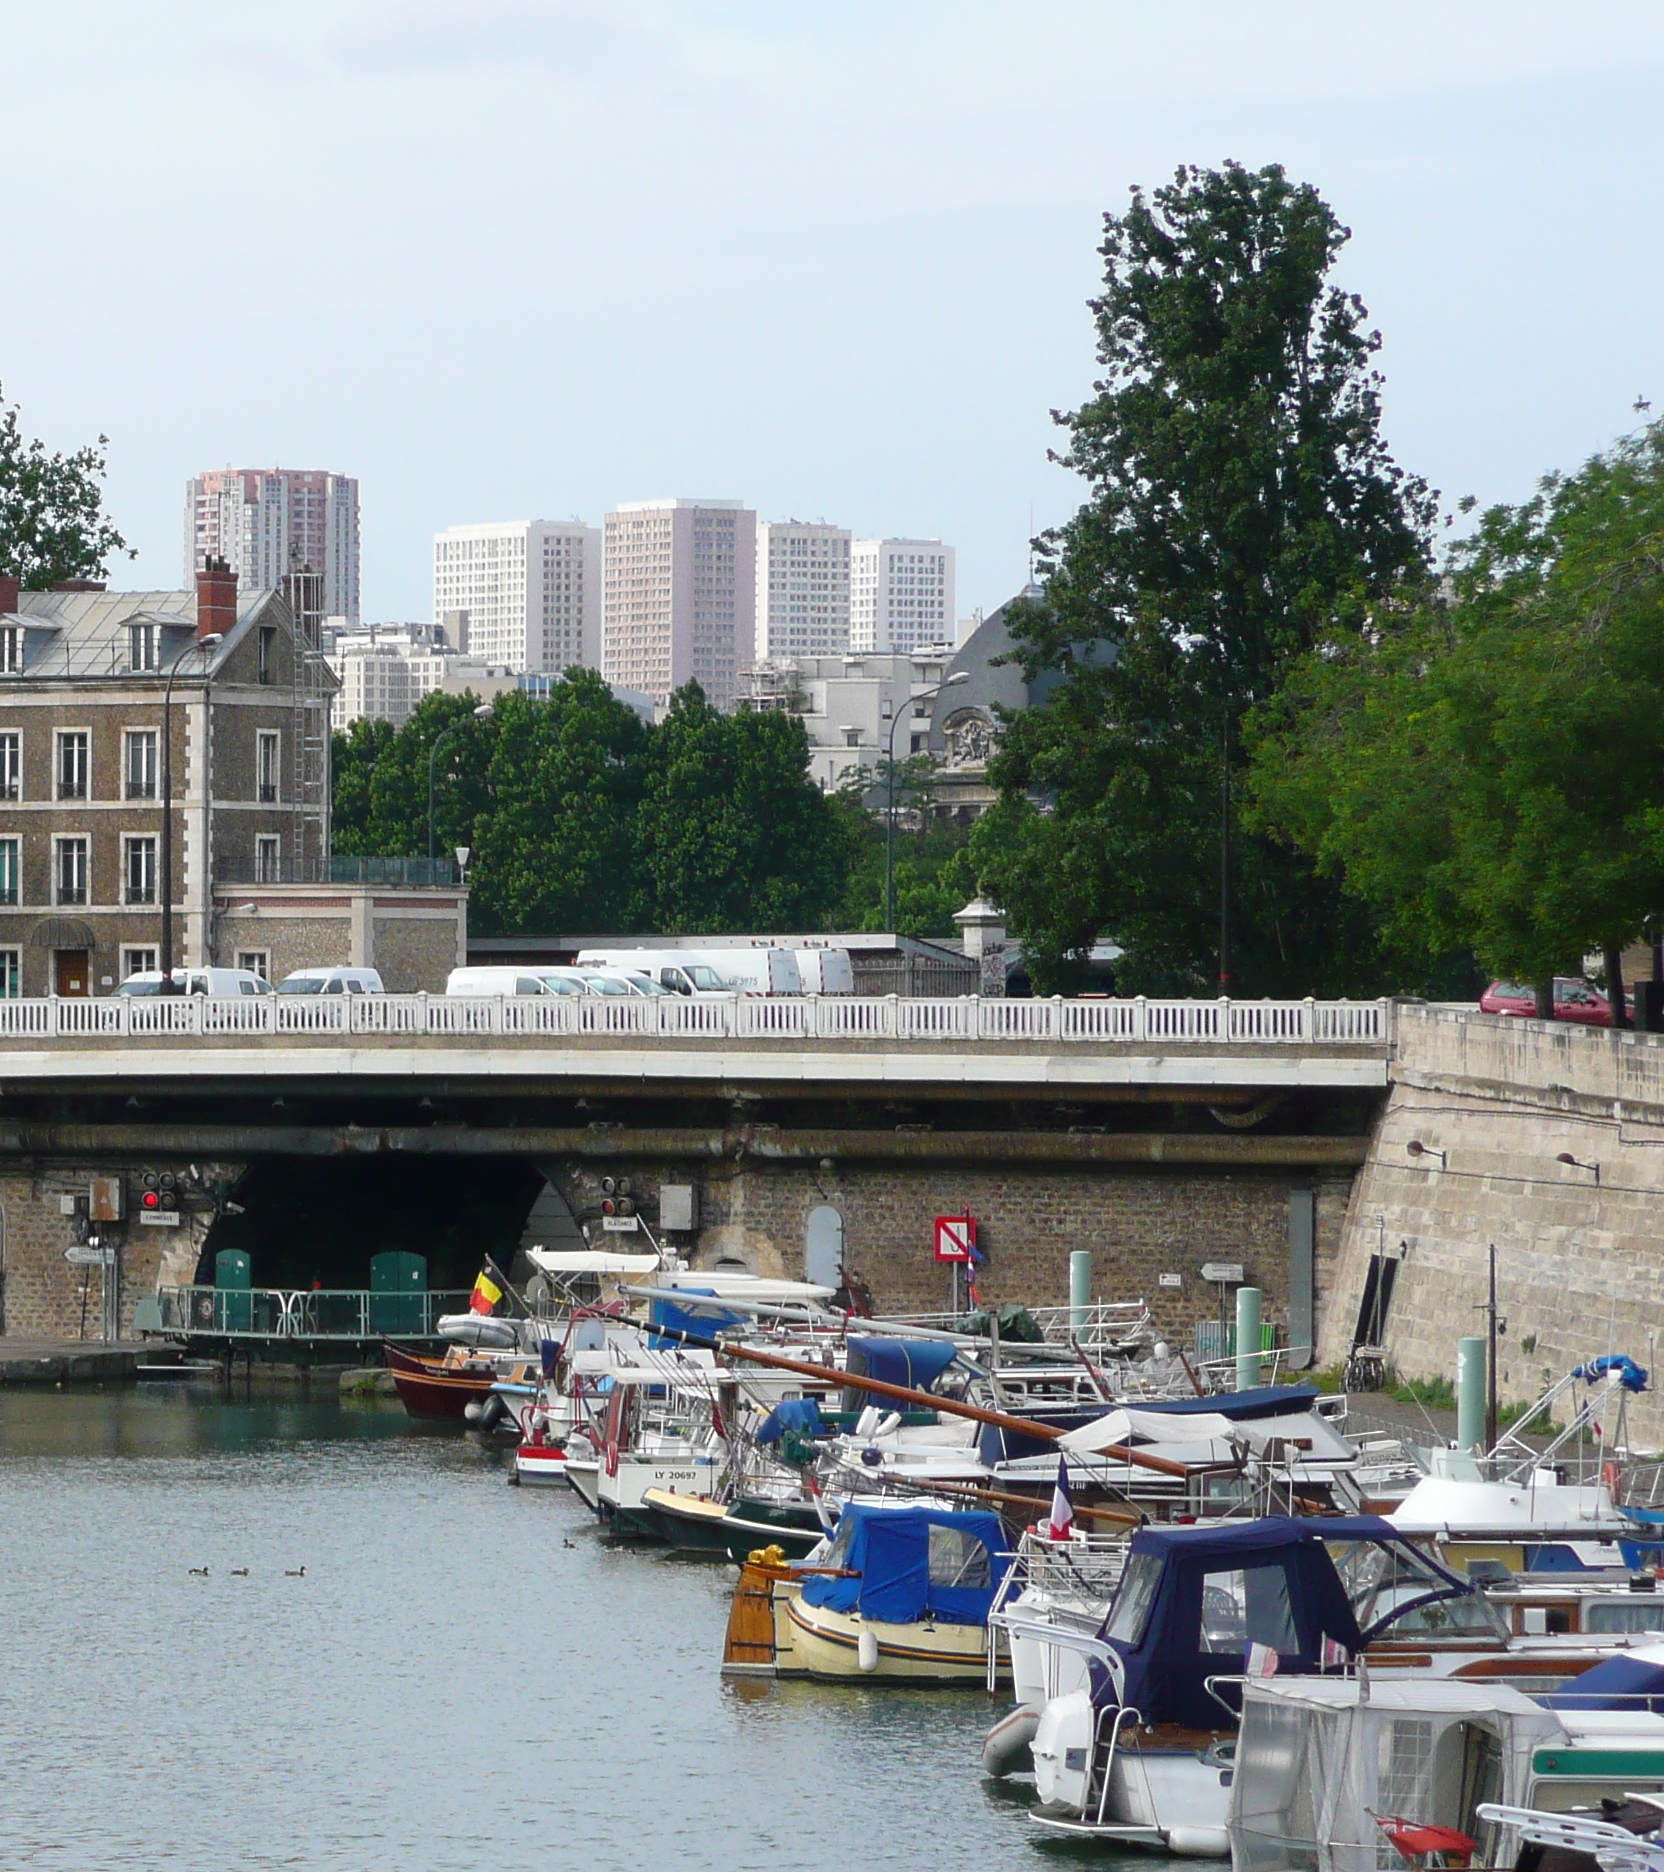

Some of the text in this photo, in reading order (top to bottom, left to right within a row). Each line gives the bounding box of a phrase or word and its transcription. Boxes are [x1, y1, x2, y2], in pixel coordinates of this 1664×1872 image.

[739, 977, 759, 986] 3975
[655, 1471, 696, 1479] LY 20697
